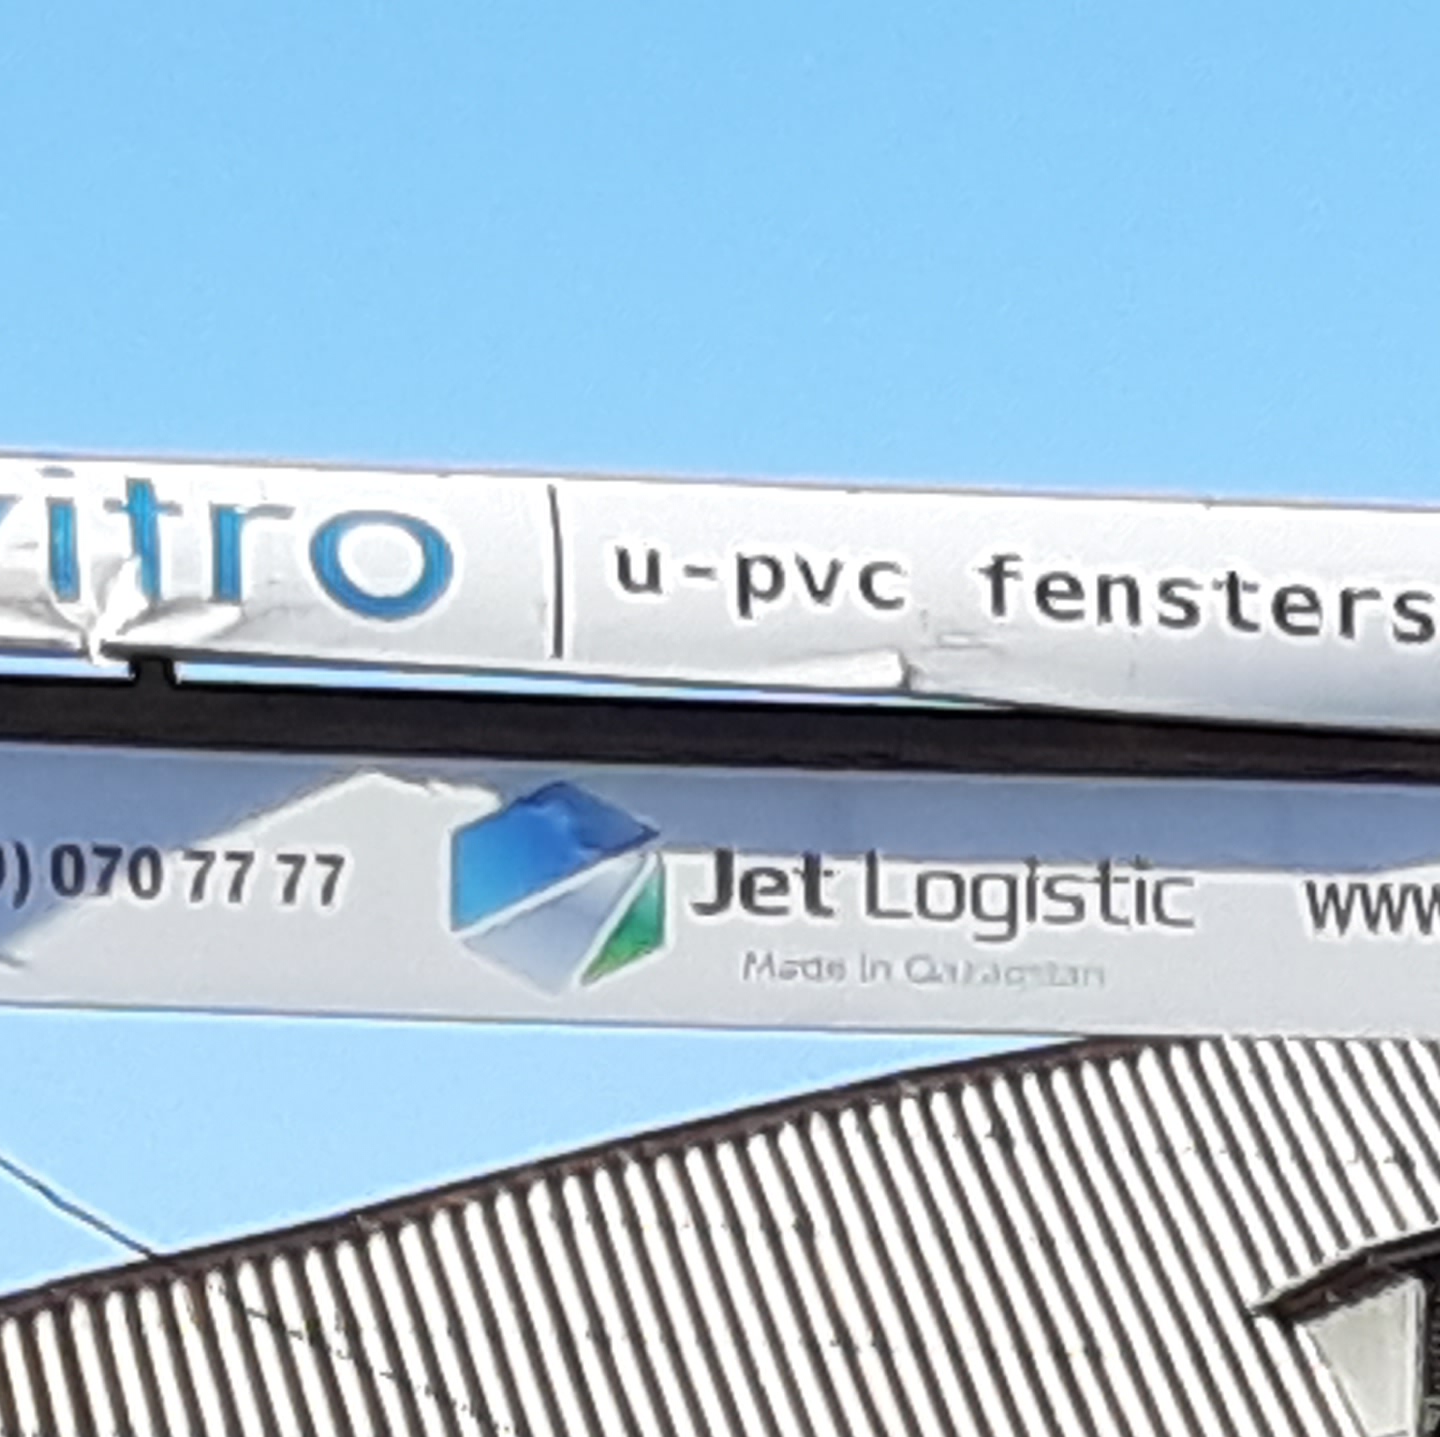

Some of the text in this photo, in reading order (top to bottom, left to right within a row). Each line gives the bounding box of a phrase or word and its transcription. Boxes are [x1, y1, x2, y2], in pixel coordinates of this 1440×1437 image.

[613, 540, 910, 619] u-pvc
[51, 842, 163, 902] 070
[187, 849, 256, 905] 77
[277, 852, 347, 907] 77
[689, 847, 1198, 944] Jet Logistic
